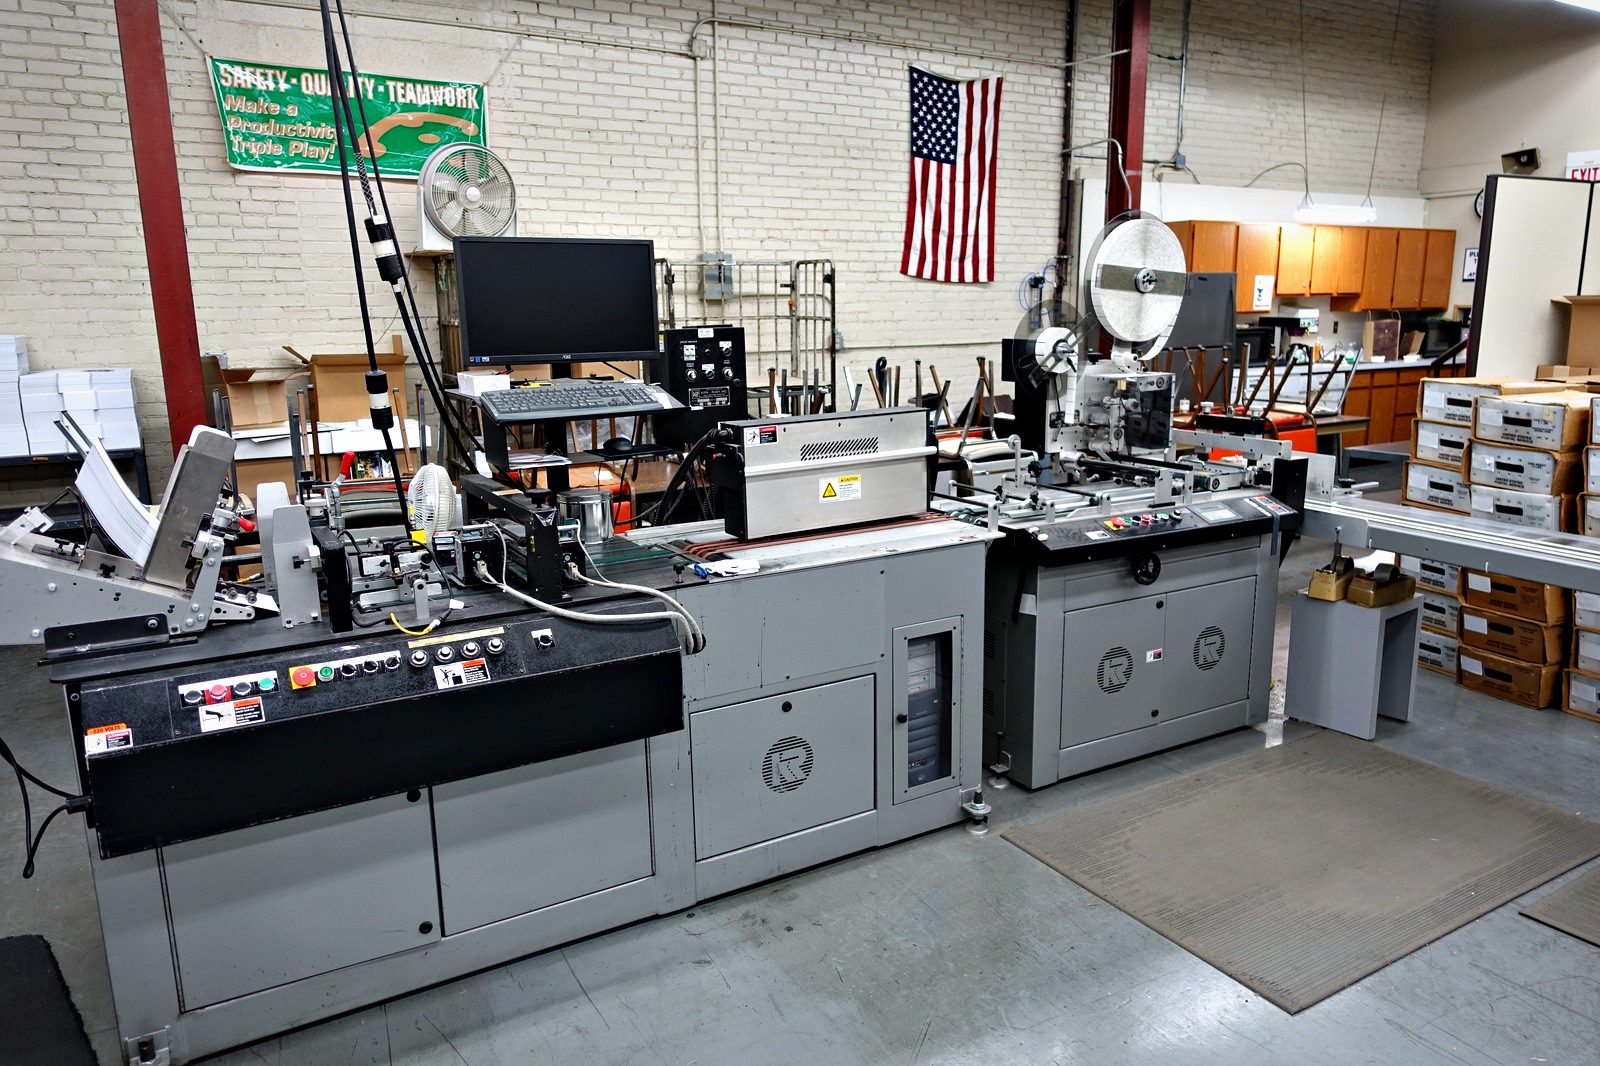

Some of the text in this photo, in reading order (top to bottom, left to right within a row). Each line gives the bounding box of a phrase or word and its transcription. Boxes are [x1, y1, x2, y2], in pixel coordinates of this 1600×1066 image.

[219, 63, 288, 92] SAFETY
[386, 80, 480, 109] TEAMWORK
[224, 94, 298, 116] Make a
[231, 134, 336, 162] Triple Play!
